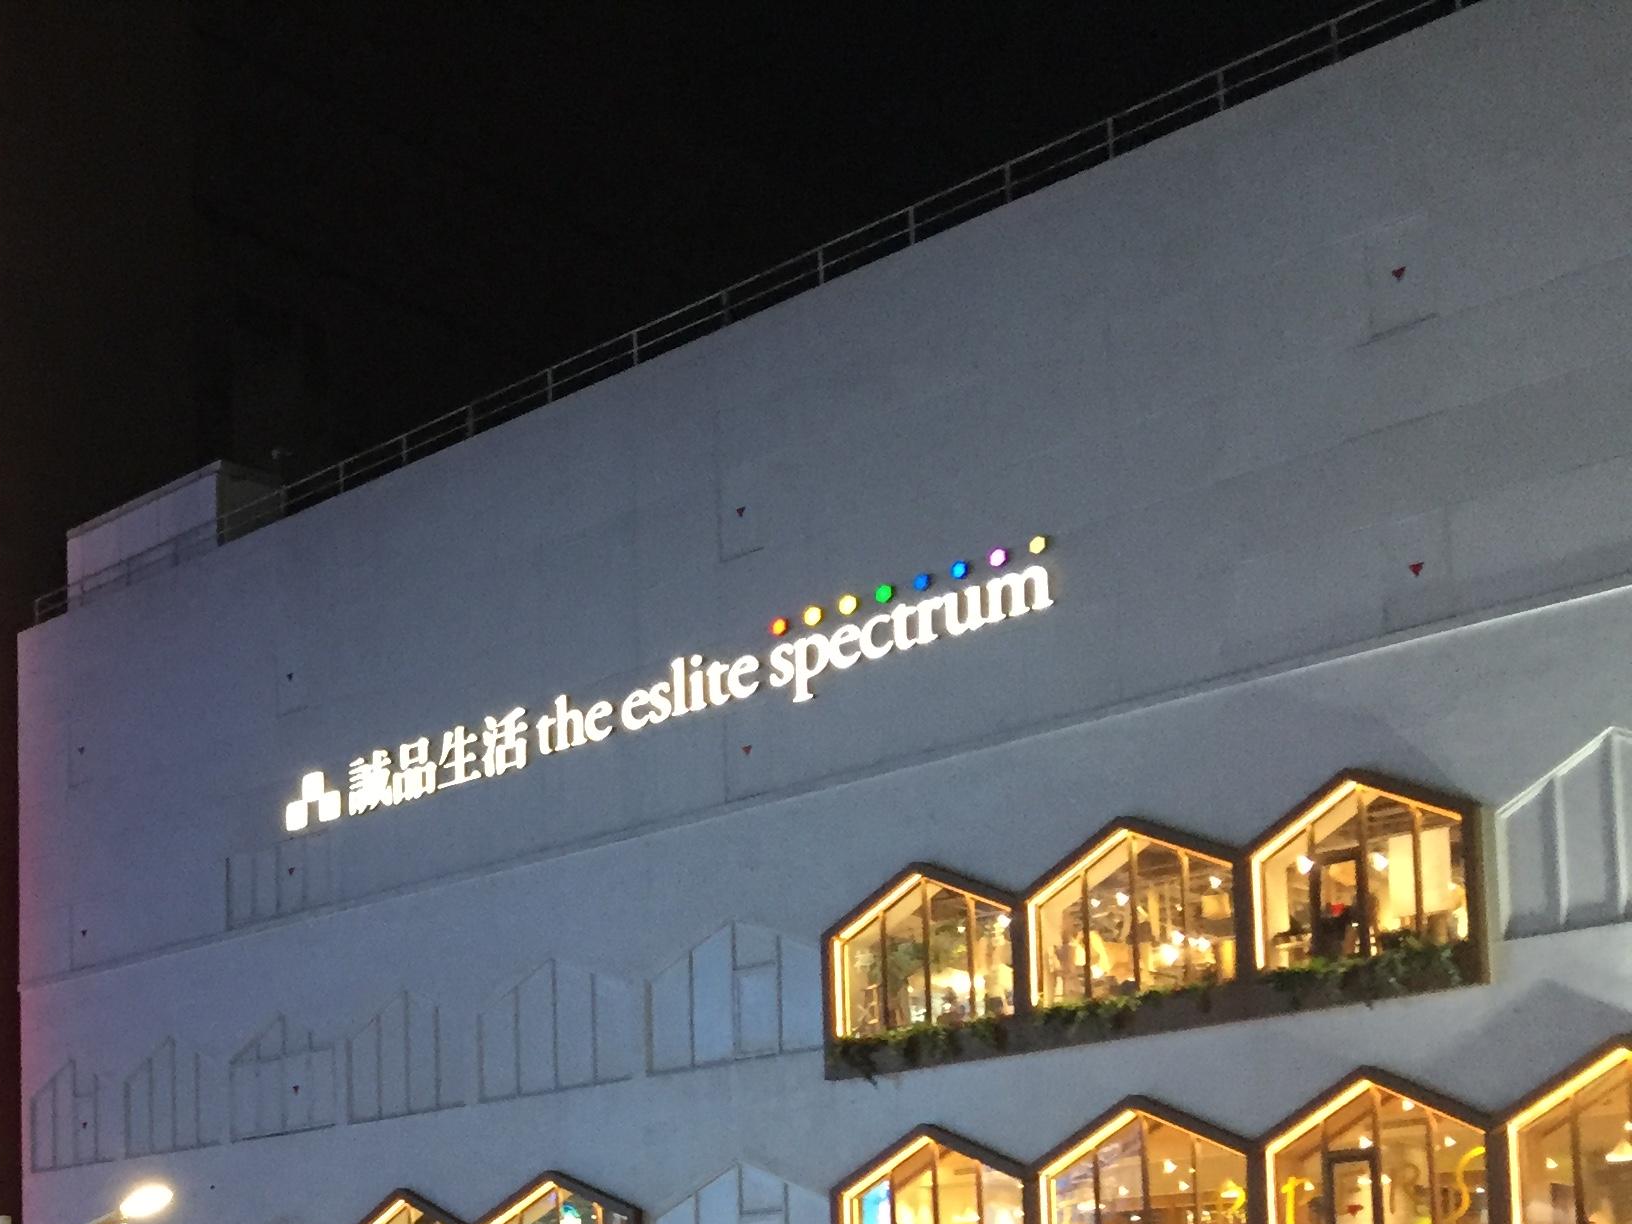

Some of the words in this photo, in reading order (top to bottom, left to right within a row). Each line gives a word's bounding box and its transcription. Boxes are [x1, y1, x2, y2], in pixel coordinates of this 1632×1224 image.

[535, 694, 613, 755] the
[620, 654, 760, 732] eslite
[769, 564, 1054, 703] spectrum
[348, 705, 529, 815] 誠品生活
